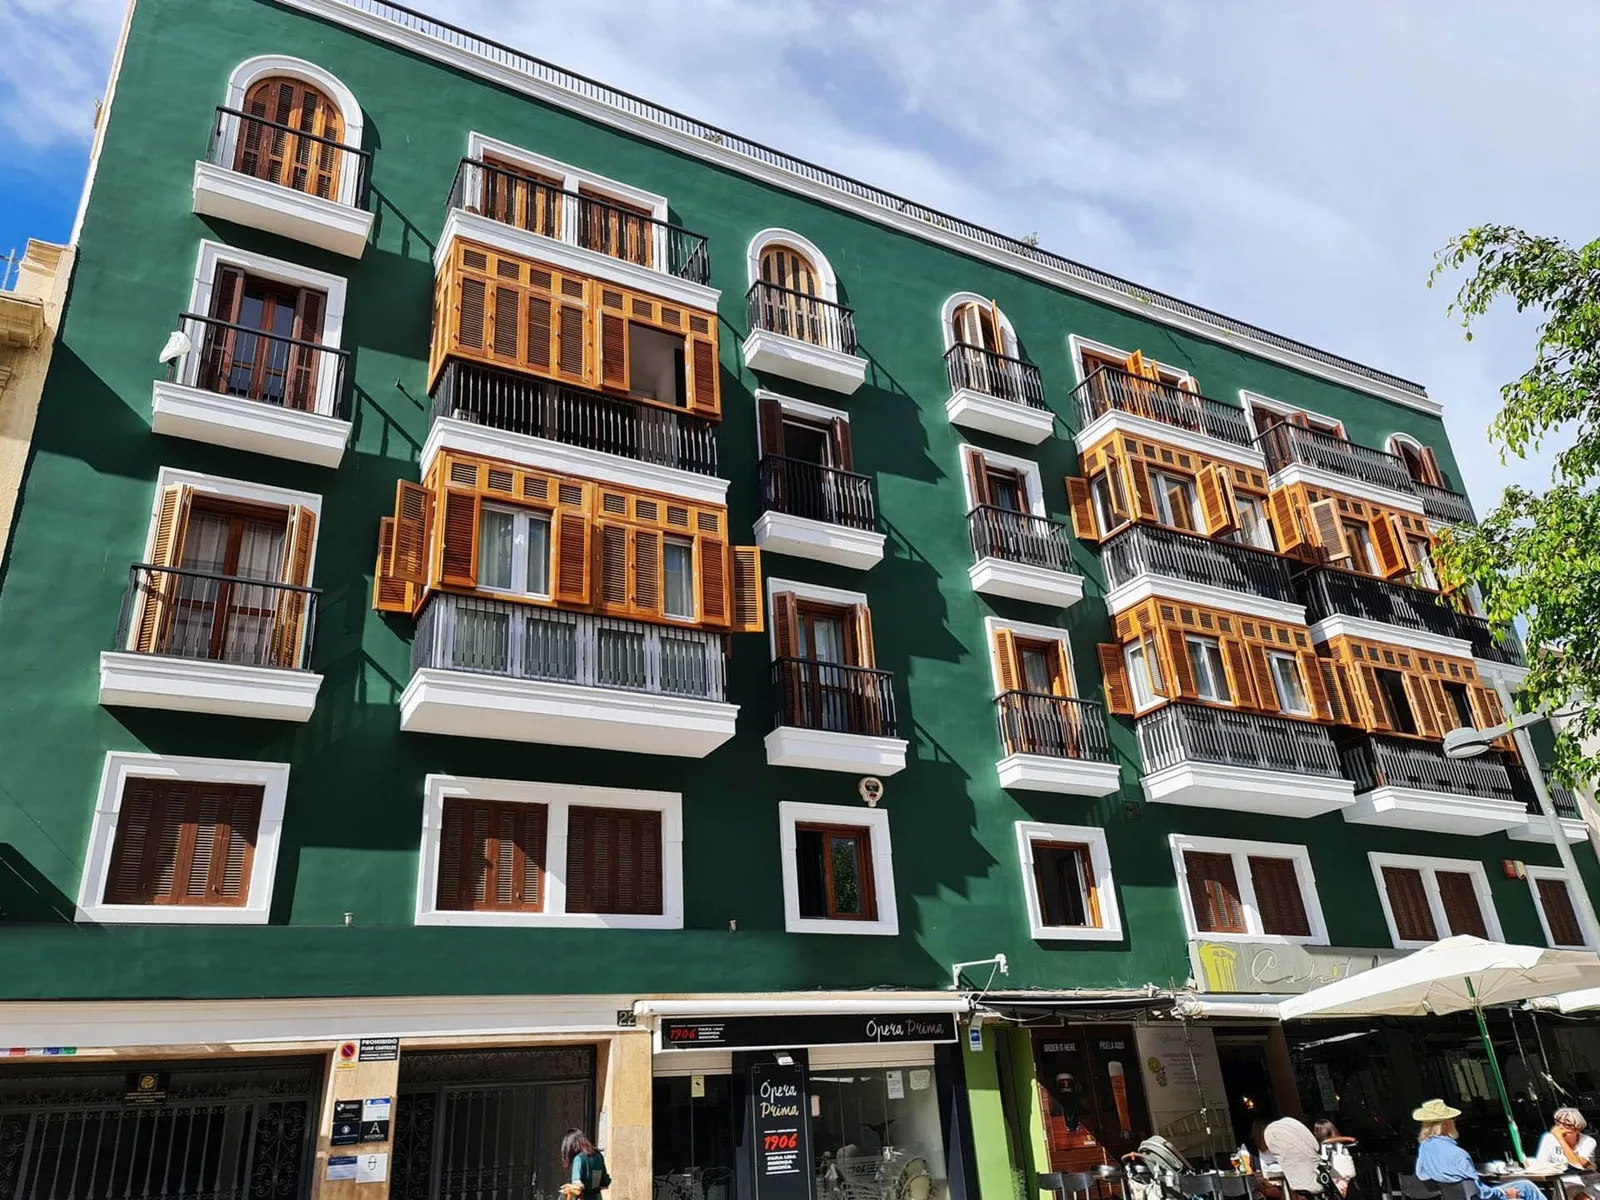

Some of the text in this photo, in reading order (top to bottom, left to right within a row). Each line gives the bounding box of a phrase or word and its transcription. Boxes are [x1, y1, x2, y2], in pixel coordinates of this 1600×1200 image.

[619, 1011, 636, 1025] 22
[670, 1028, 697, 1040] 1906
[866, 1017, 944, 1043] Ópera Prima
[760, 1079, 797, 1104] Ópera
[760, 1102, 799, 1118] Prima
[764, 1133, 798, 1151] 1906
